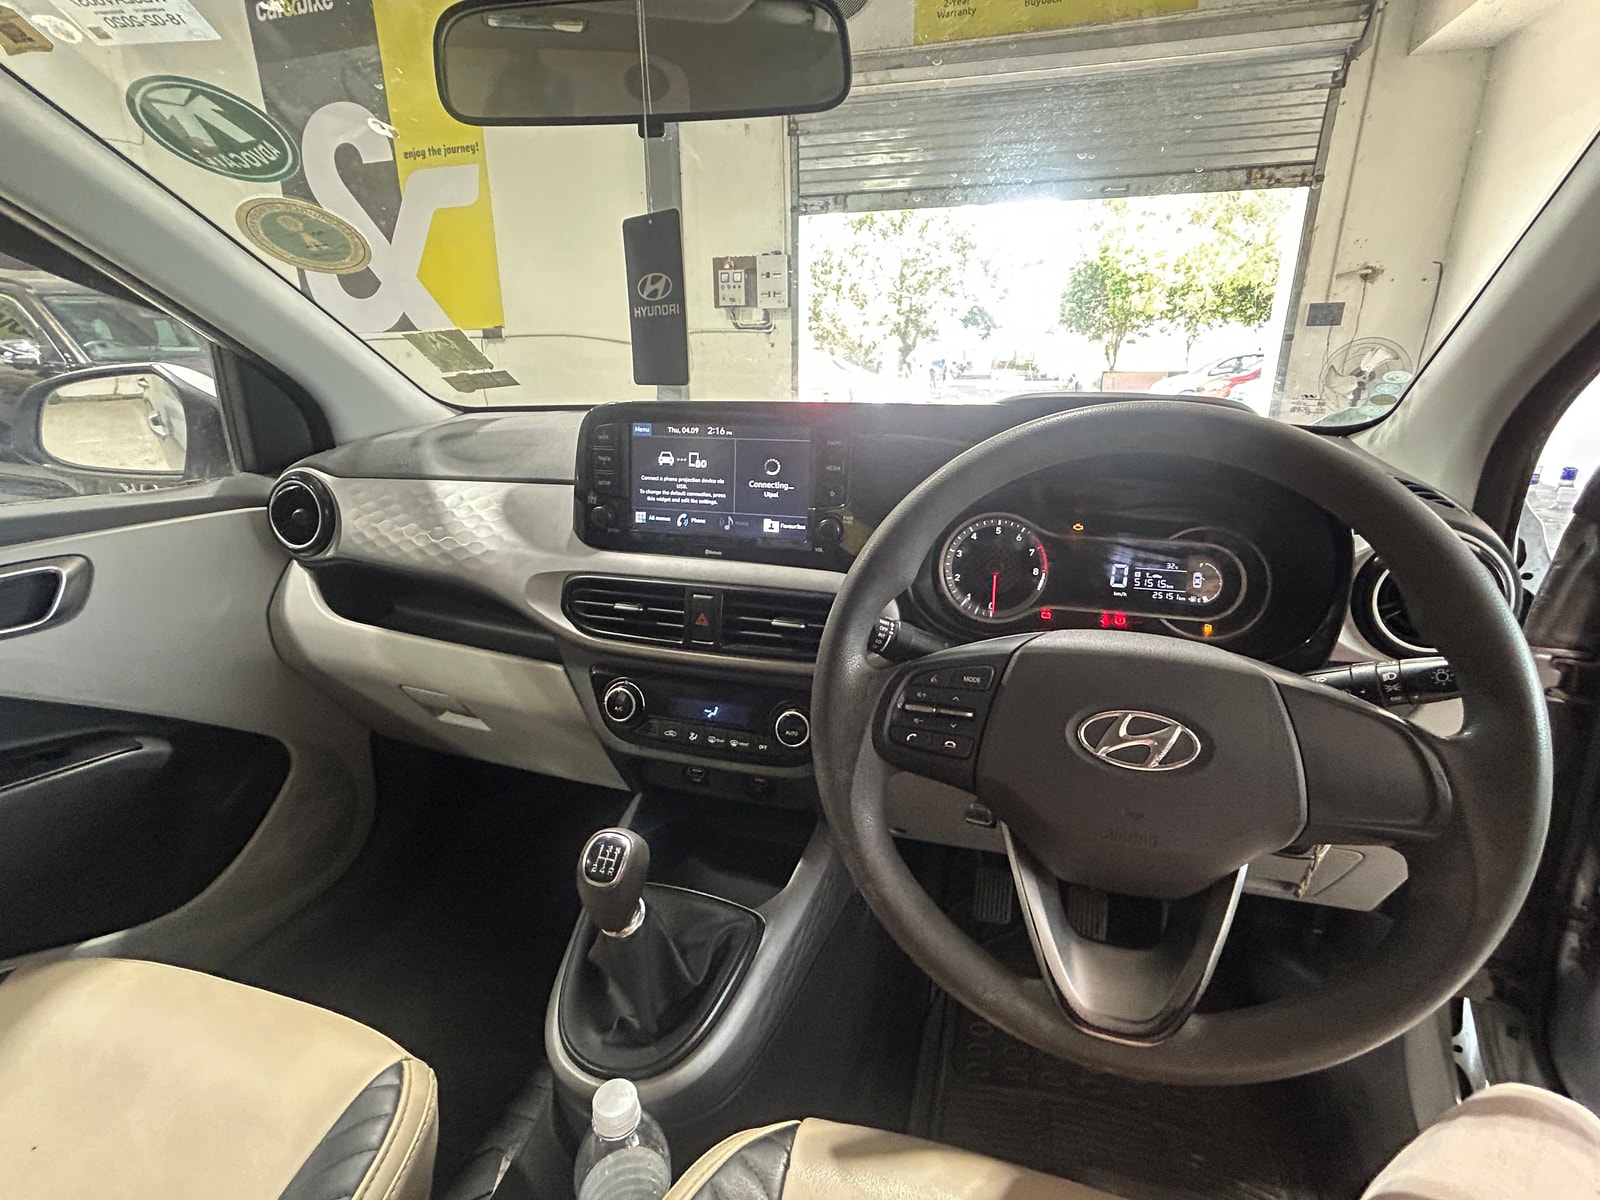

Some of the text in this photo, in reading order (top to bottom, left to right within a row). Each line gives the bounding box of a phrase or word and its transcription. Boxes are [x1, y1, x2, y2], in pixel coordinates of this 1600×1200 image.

[937, 8, 976, 19] Warranty
[404, 142, 479, 160] enjoy the journey!
[634, 304, 680, 318] HYUNDAI
[707, 427, 725, 435] 2:16
[1110, 563, 1129, 588] 0
[591, 864, 598, 873] 2
